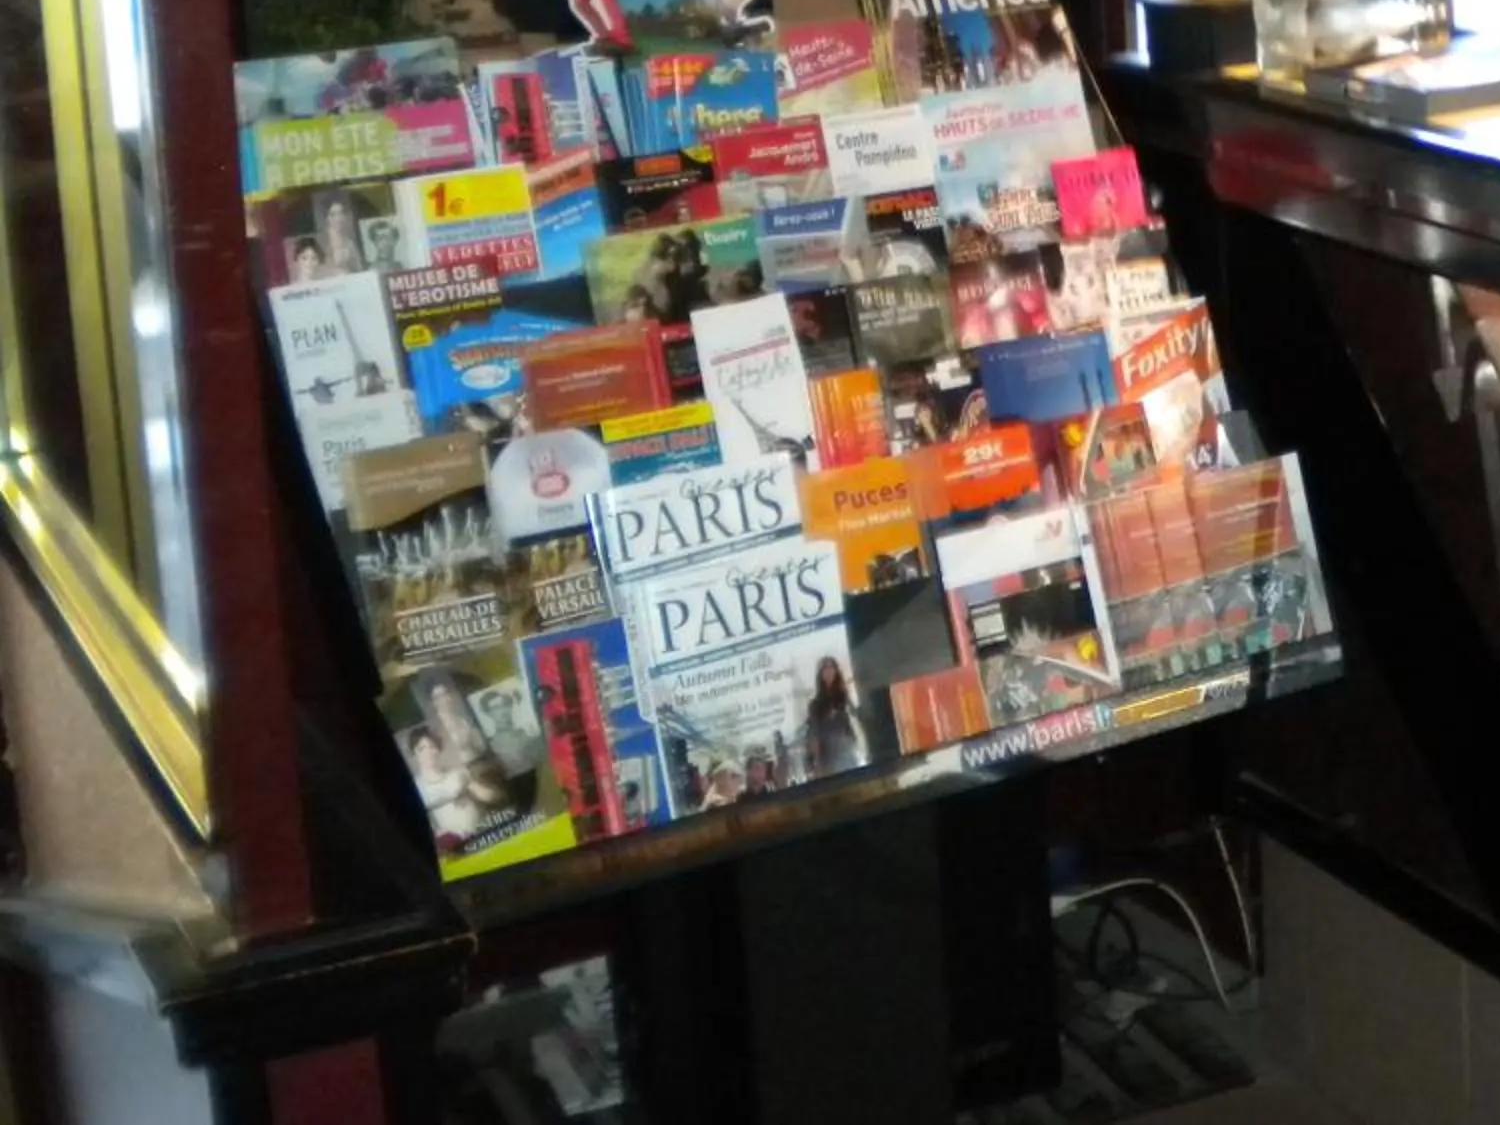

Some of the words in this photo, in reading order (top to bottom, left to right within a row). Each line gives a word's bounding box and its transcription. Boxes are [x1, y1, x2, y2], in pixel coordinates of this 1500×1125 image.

[835, 132, 879, 150] Centre
[855, 145, 917, 167] Pompidou
[292, 151, 384, 185] PARIS
[433, 237, 534, 263] VEDETTES
[452, 264, 478, 281] DE
[391, 278, 498, 309] L'EROTISME
[290, 324, 339, 348] PLAN
[1120, 318, 1202, 388] Foxity
[833, 482, 908, 511] Puces
[614, 481, 784, 564] PARIS
[656, 565, 827, 655] PARIS
[401, 616, 501, 649] VERSAILLES
